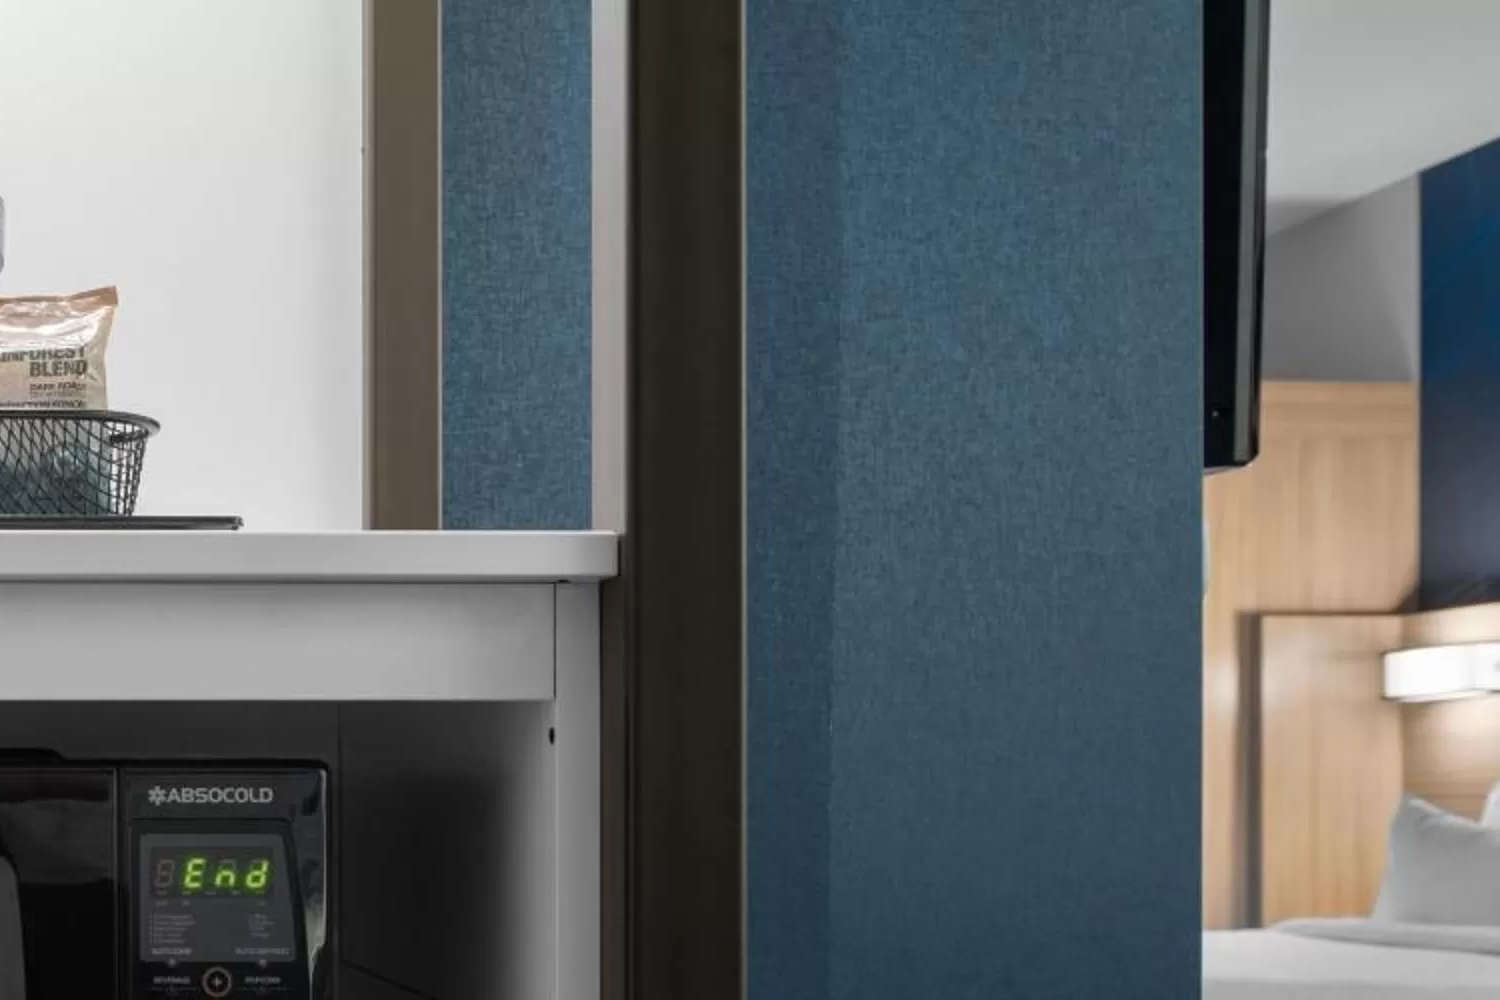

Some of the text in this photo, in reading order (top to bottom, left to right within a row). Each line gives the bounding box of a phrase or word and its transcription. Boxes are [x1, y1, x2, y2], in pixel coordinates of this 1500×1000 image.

[29, 360, 88, 378] BLEND
[165, 786, 274, 804] ABSOCOLD
[183, 857, 270, 889] End
